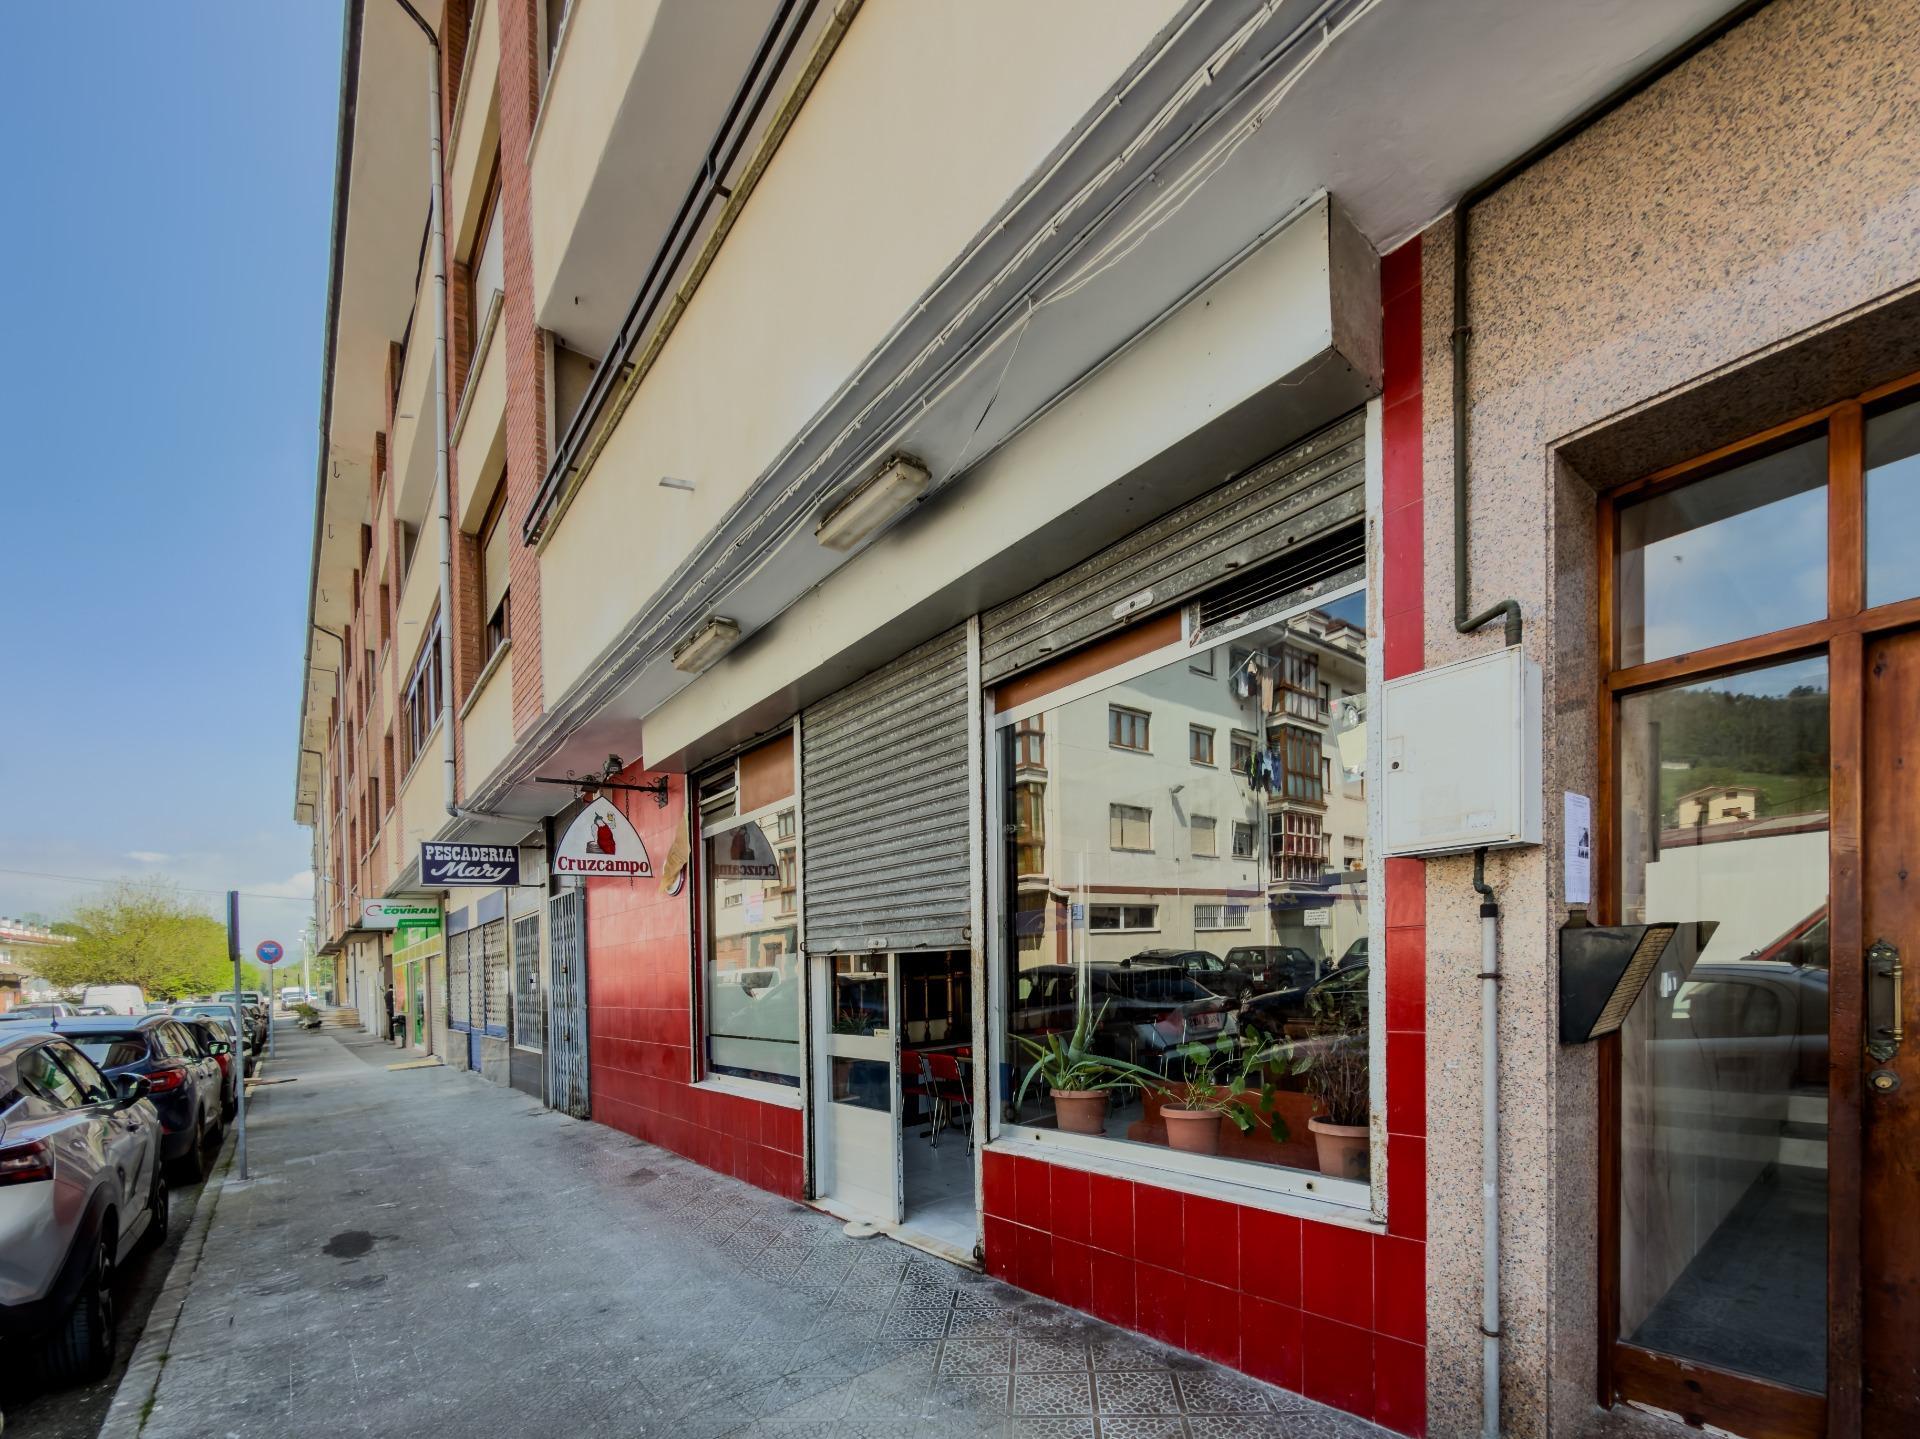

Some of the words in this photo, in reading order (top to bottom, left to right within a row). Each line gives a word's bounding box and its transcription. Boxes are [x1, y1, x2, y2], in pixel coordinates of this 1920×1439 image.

[425, 845, 515, 862] PESCADERIA
[430, 861, 511, 883] Mary
[557, 856, 649, 874] Cruzcampo
